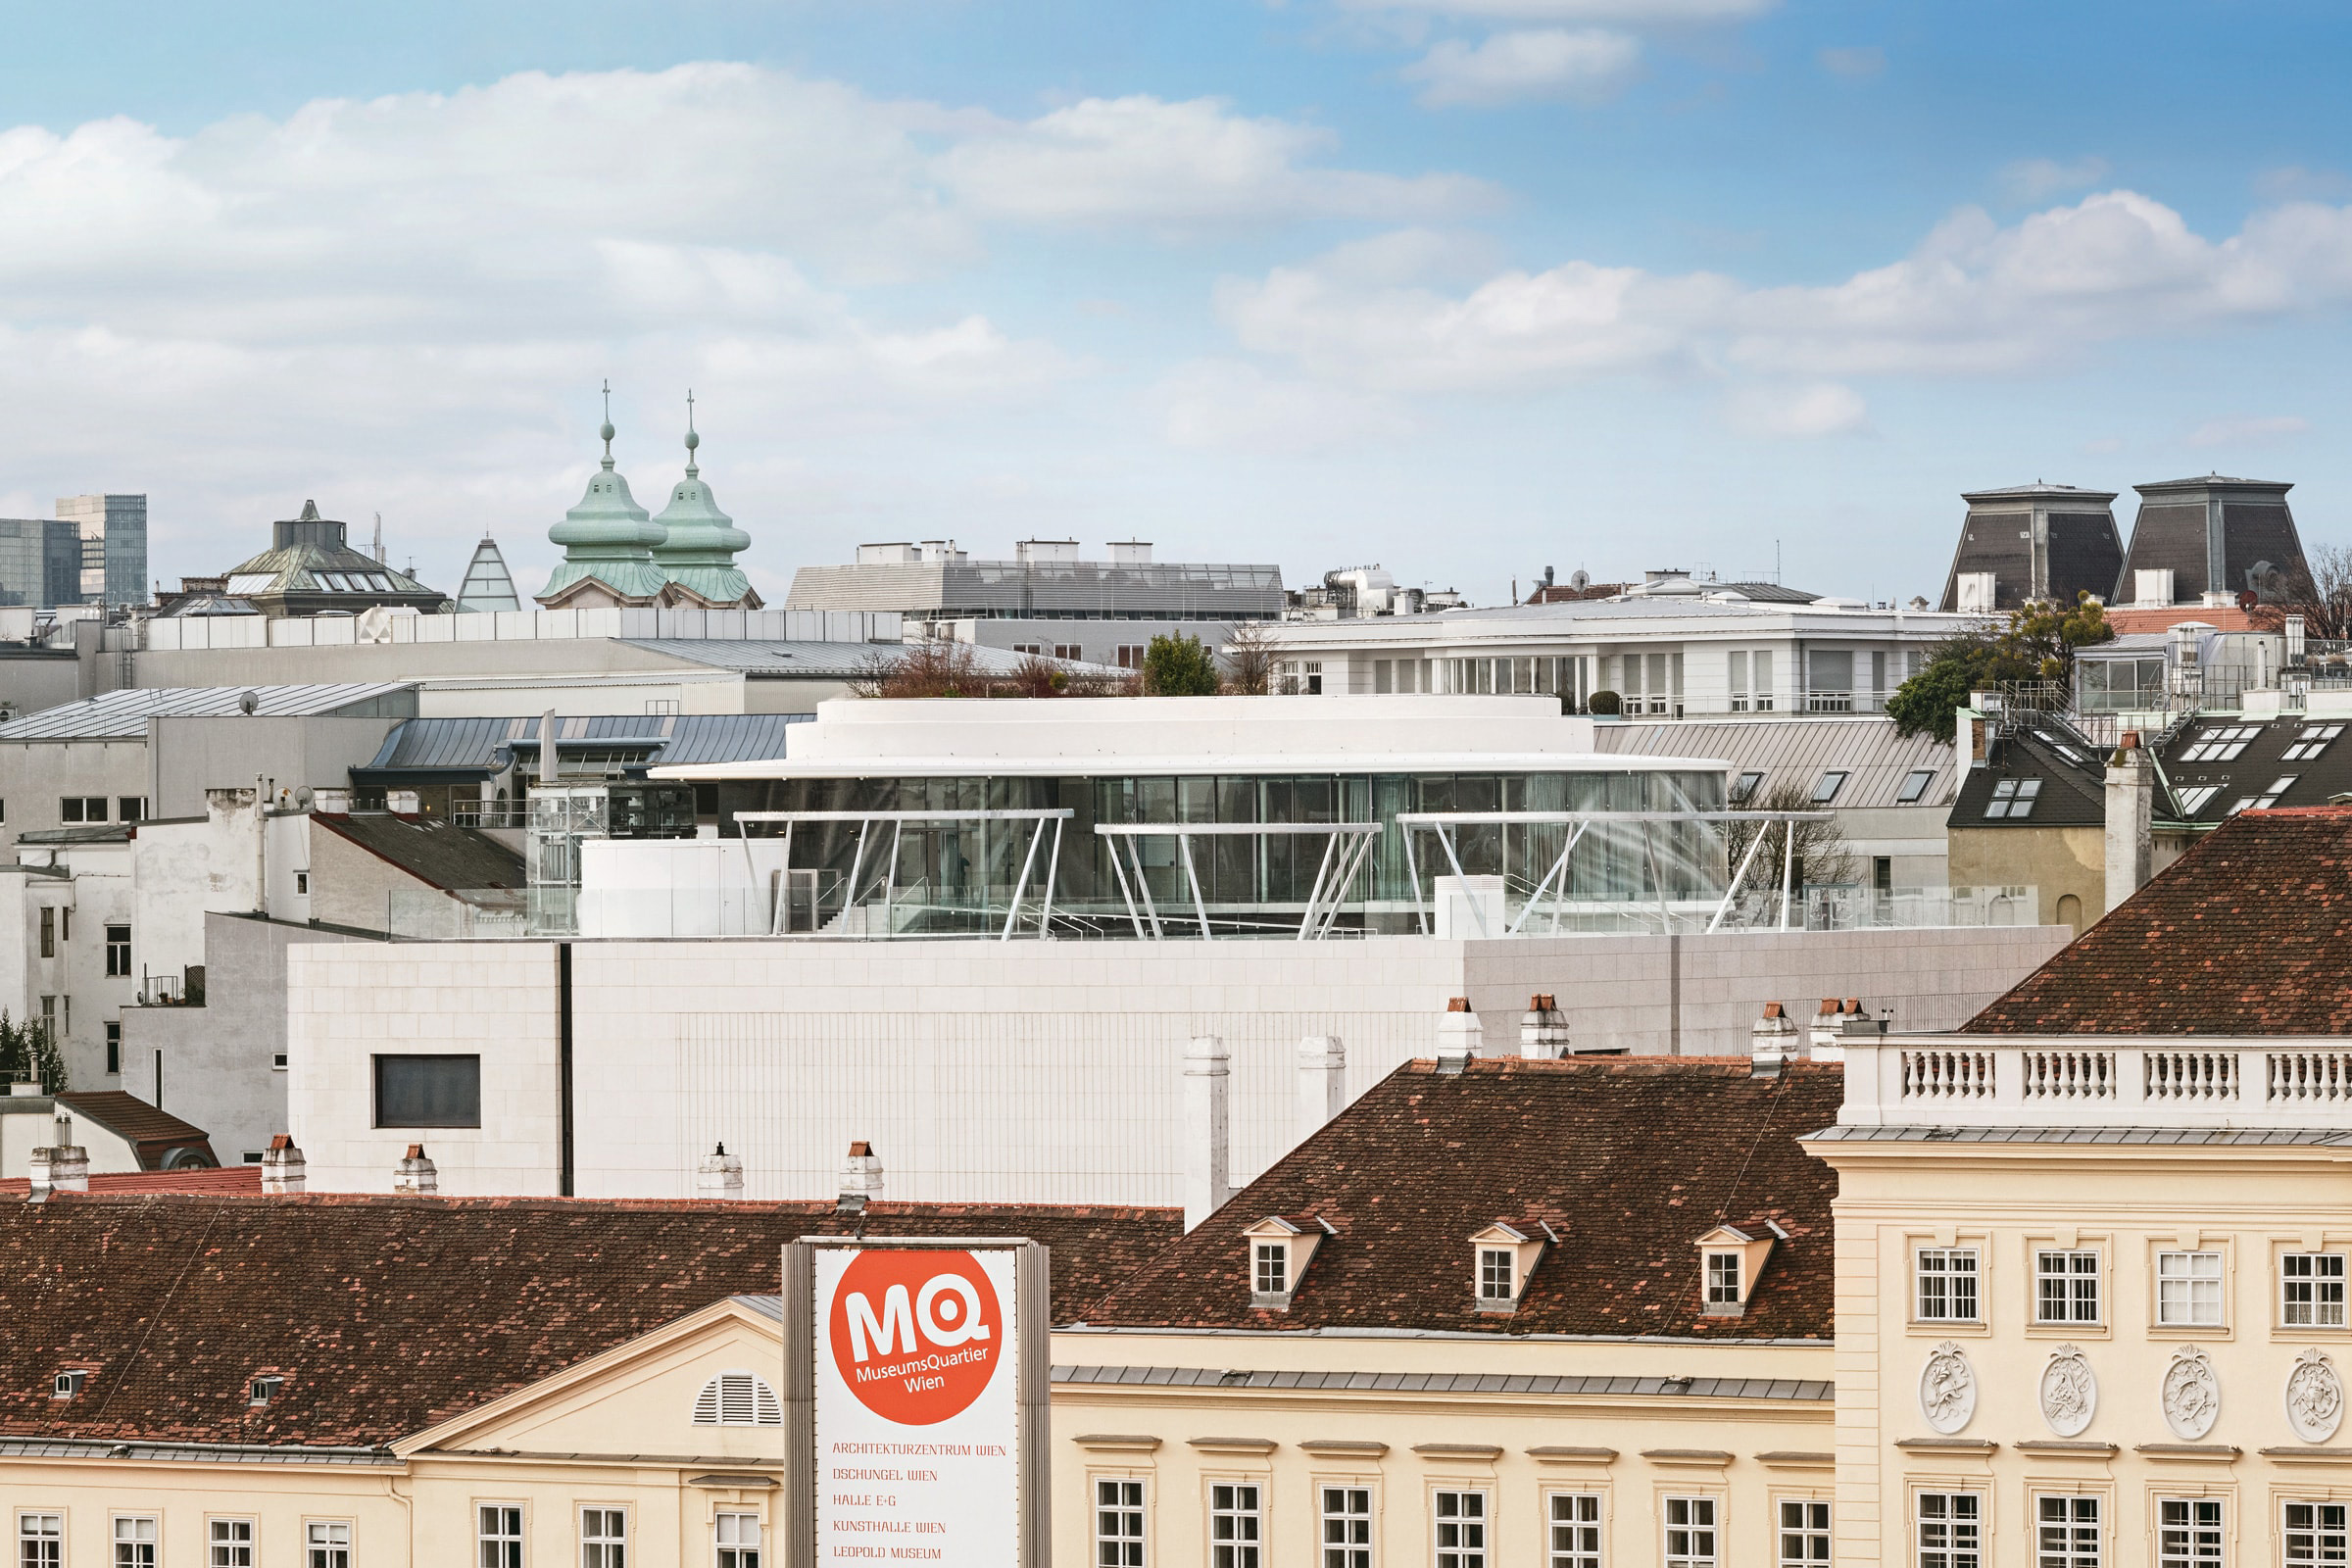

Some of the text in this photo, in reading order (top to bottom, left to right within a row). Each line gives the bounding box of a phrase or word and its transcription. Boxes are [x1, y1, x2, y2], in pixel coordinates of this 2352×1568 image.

[845, 1273, 991, 1362] MQ
[856, 1347, 989, 1383] MuseumsQuartier
[904, 1374, 945, 1394] Wien
[832, 1442, 1006, 1457] ARCHITEKTURZENTRUM WIEN
[832, 1468, 938, 1482] DSCHUNGEL WIEN
[832, 1494, 871, 1506] HALLE
[833, 1520, 946, 1534] KUNSTHALLE WIEN
[833, 1545, 942, 1560] LEOPOLD MUSEUM
